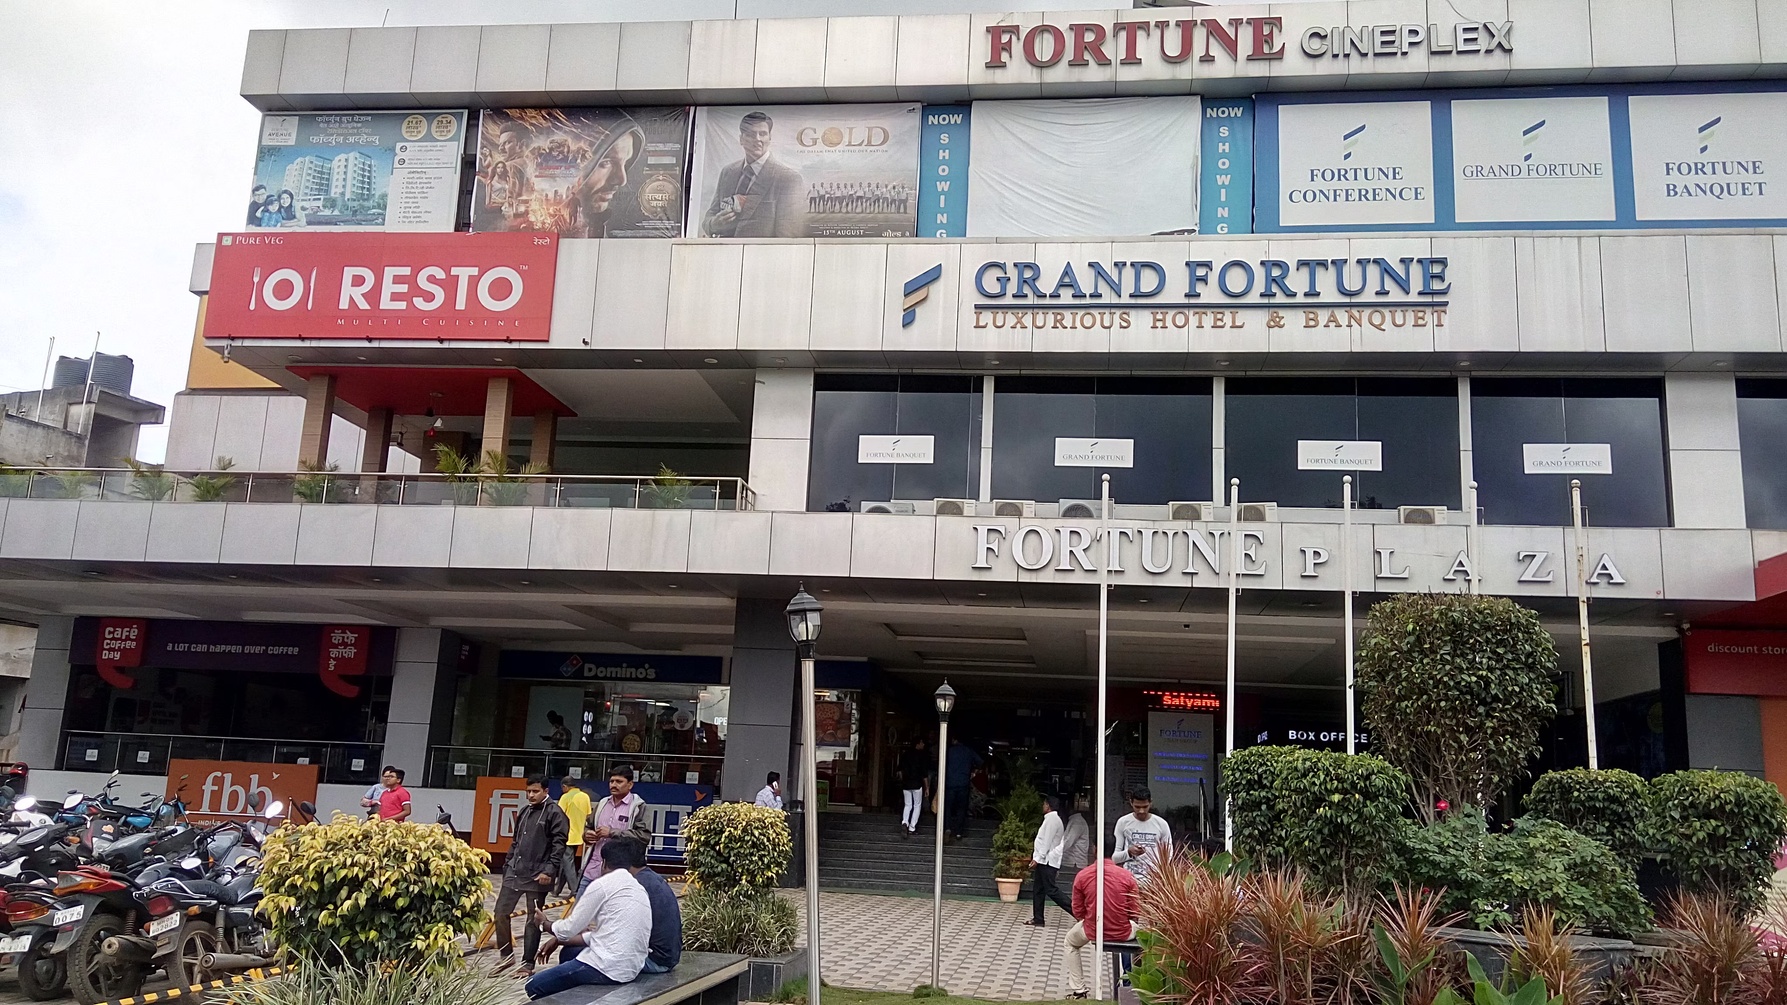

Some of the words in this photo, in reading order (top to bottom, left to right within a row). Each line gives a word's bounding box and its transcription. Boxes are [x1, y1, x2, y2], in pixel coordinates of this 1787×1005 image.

[984, 16, 1286, 68] FORTUNE
[1300, 21, 1514, 58] CINEPLEX
[928, 113, 963, 125] NOW
[1206, 107, 1244, 118] NOW
[796, 125, 890, 148] GOLD
[1309, 166, 1404, 182] FORTUNE
[1462, 163, 1522, 178] GRAND
[1525, 162, 1603, 177] FORTUNE
[1664, 160, 1765, 176] FORTUNE
[935, 133, 951, 238] SHOWING
[1216, 126, 1231, 234] SHOWING
[1288, 186, 1426, 204] CONFERENCE
[1665, 181, 1767, 200] BANQUET
[236, 236, 261, 245] PURE
[264, 235, 284, 245] VEG
[974, 260, 1167, 299] GRAND
[1184, 256, 1452, 299] FORTUNE
[338, 265, 524, 312] RESTO
[336, 318, 402, 326] MULTI
[422, 318, 520, 327] CUISINE
[973, 310, 1132, 330] LUXURIOUS
[1150, 310, 1246, 329] HOTEL
[1265, 310, 1286, 328] &
[1302, 308, 1448, 331] BANQUET
[1339, 458, 1373, 466] BANQUET
[971, 524, 1267, 576] FORTUNE
[1300, 546, 1627, 585] PLAZA
[105, 625, 138, 639] Café
[102, 650, 121, 660] Day
[174, 643, 189, 652] LOT
[1707, 642, 1758, 654] discount
[583, 663, 656, 679] Domino's
[1159, 729, 1202, 739] FORTUNE
[1288, 730, 1316, 741] BOX
[199, 771, 273, 814] fbb
[54, 910, 82, 926] 0075
